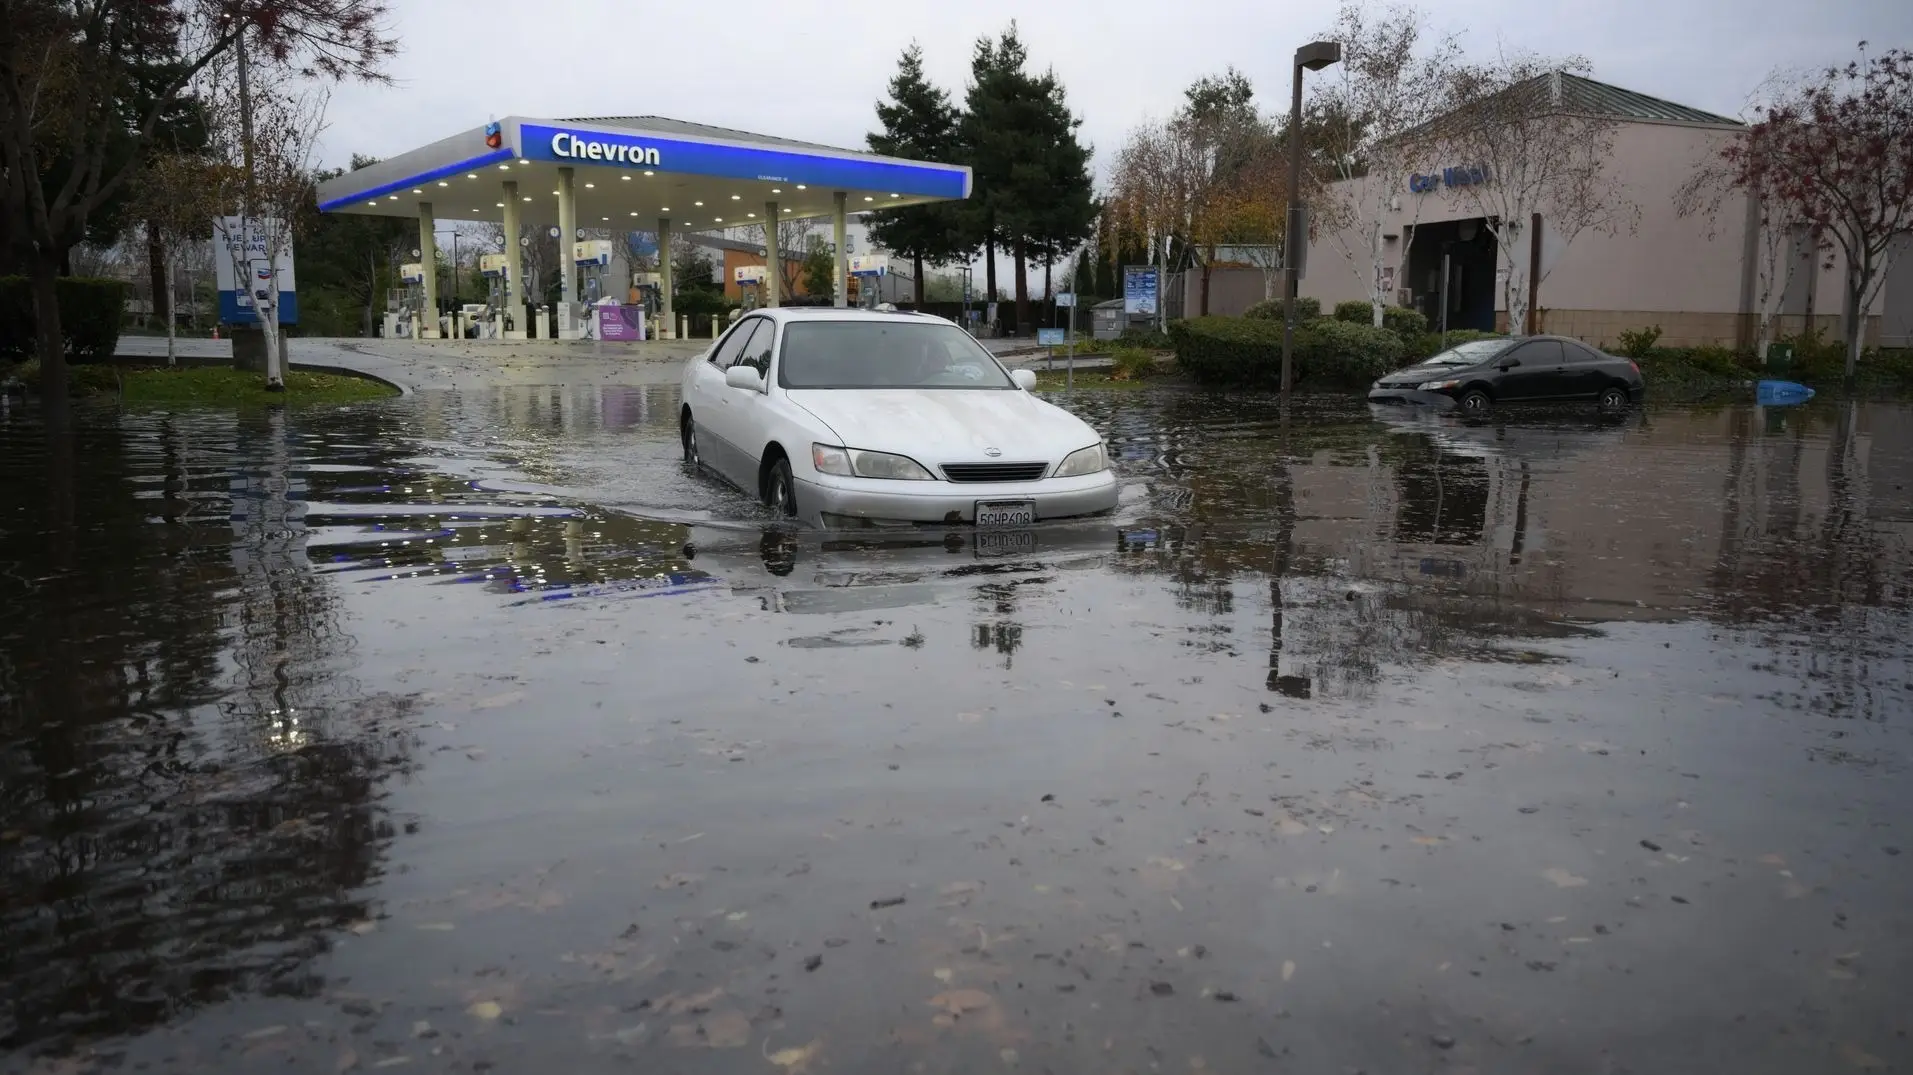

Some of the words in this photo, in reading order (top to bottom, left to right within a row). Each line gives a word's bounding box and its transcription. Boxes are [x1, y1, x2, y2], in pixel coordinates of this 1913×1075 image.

[551, 132, 660, 165] Chevron
[222, 234, 248, 242] FUE
[226, 243, 268, 253] REWAR
